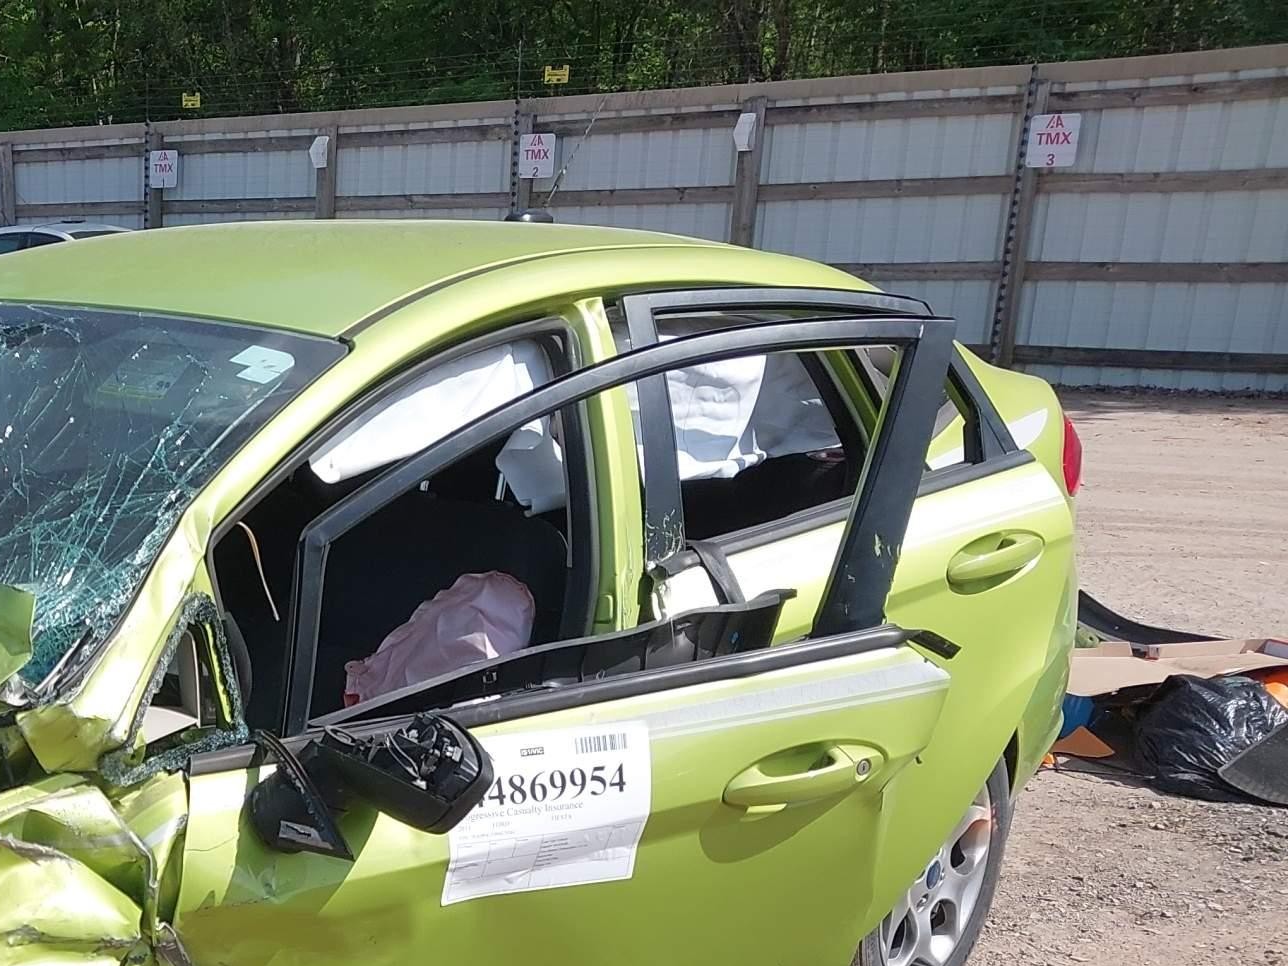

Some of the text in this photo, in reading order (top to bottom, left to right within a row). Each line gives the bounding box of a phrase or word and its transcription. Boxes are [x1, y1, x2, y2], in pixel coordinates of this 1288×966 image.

[1036, 132, 1072, 145] TMX
[524, 149, 549, 160] TMX
[1046, 153, 1055, 166] 3
[154, 163, 174, 173] TMX
[532, 167, 539, 177] 2
[477, 763, 626, 808] 4869954
[506, 804, 543, 817] Casualty
[545, 801, 583, 812] Insurance
